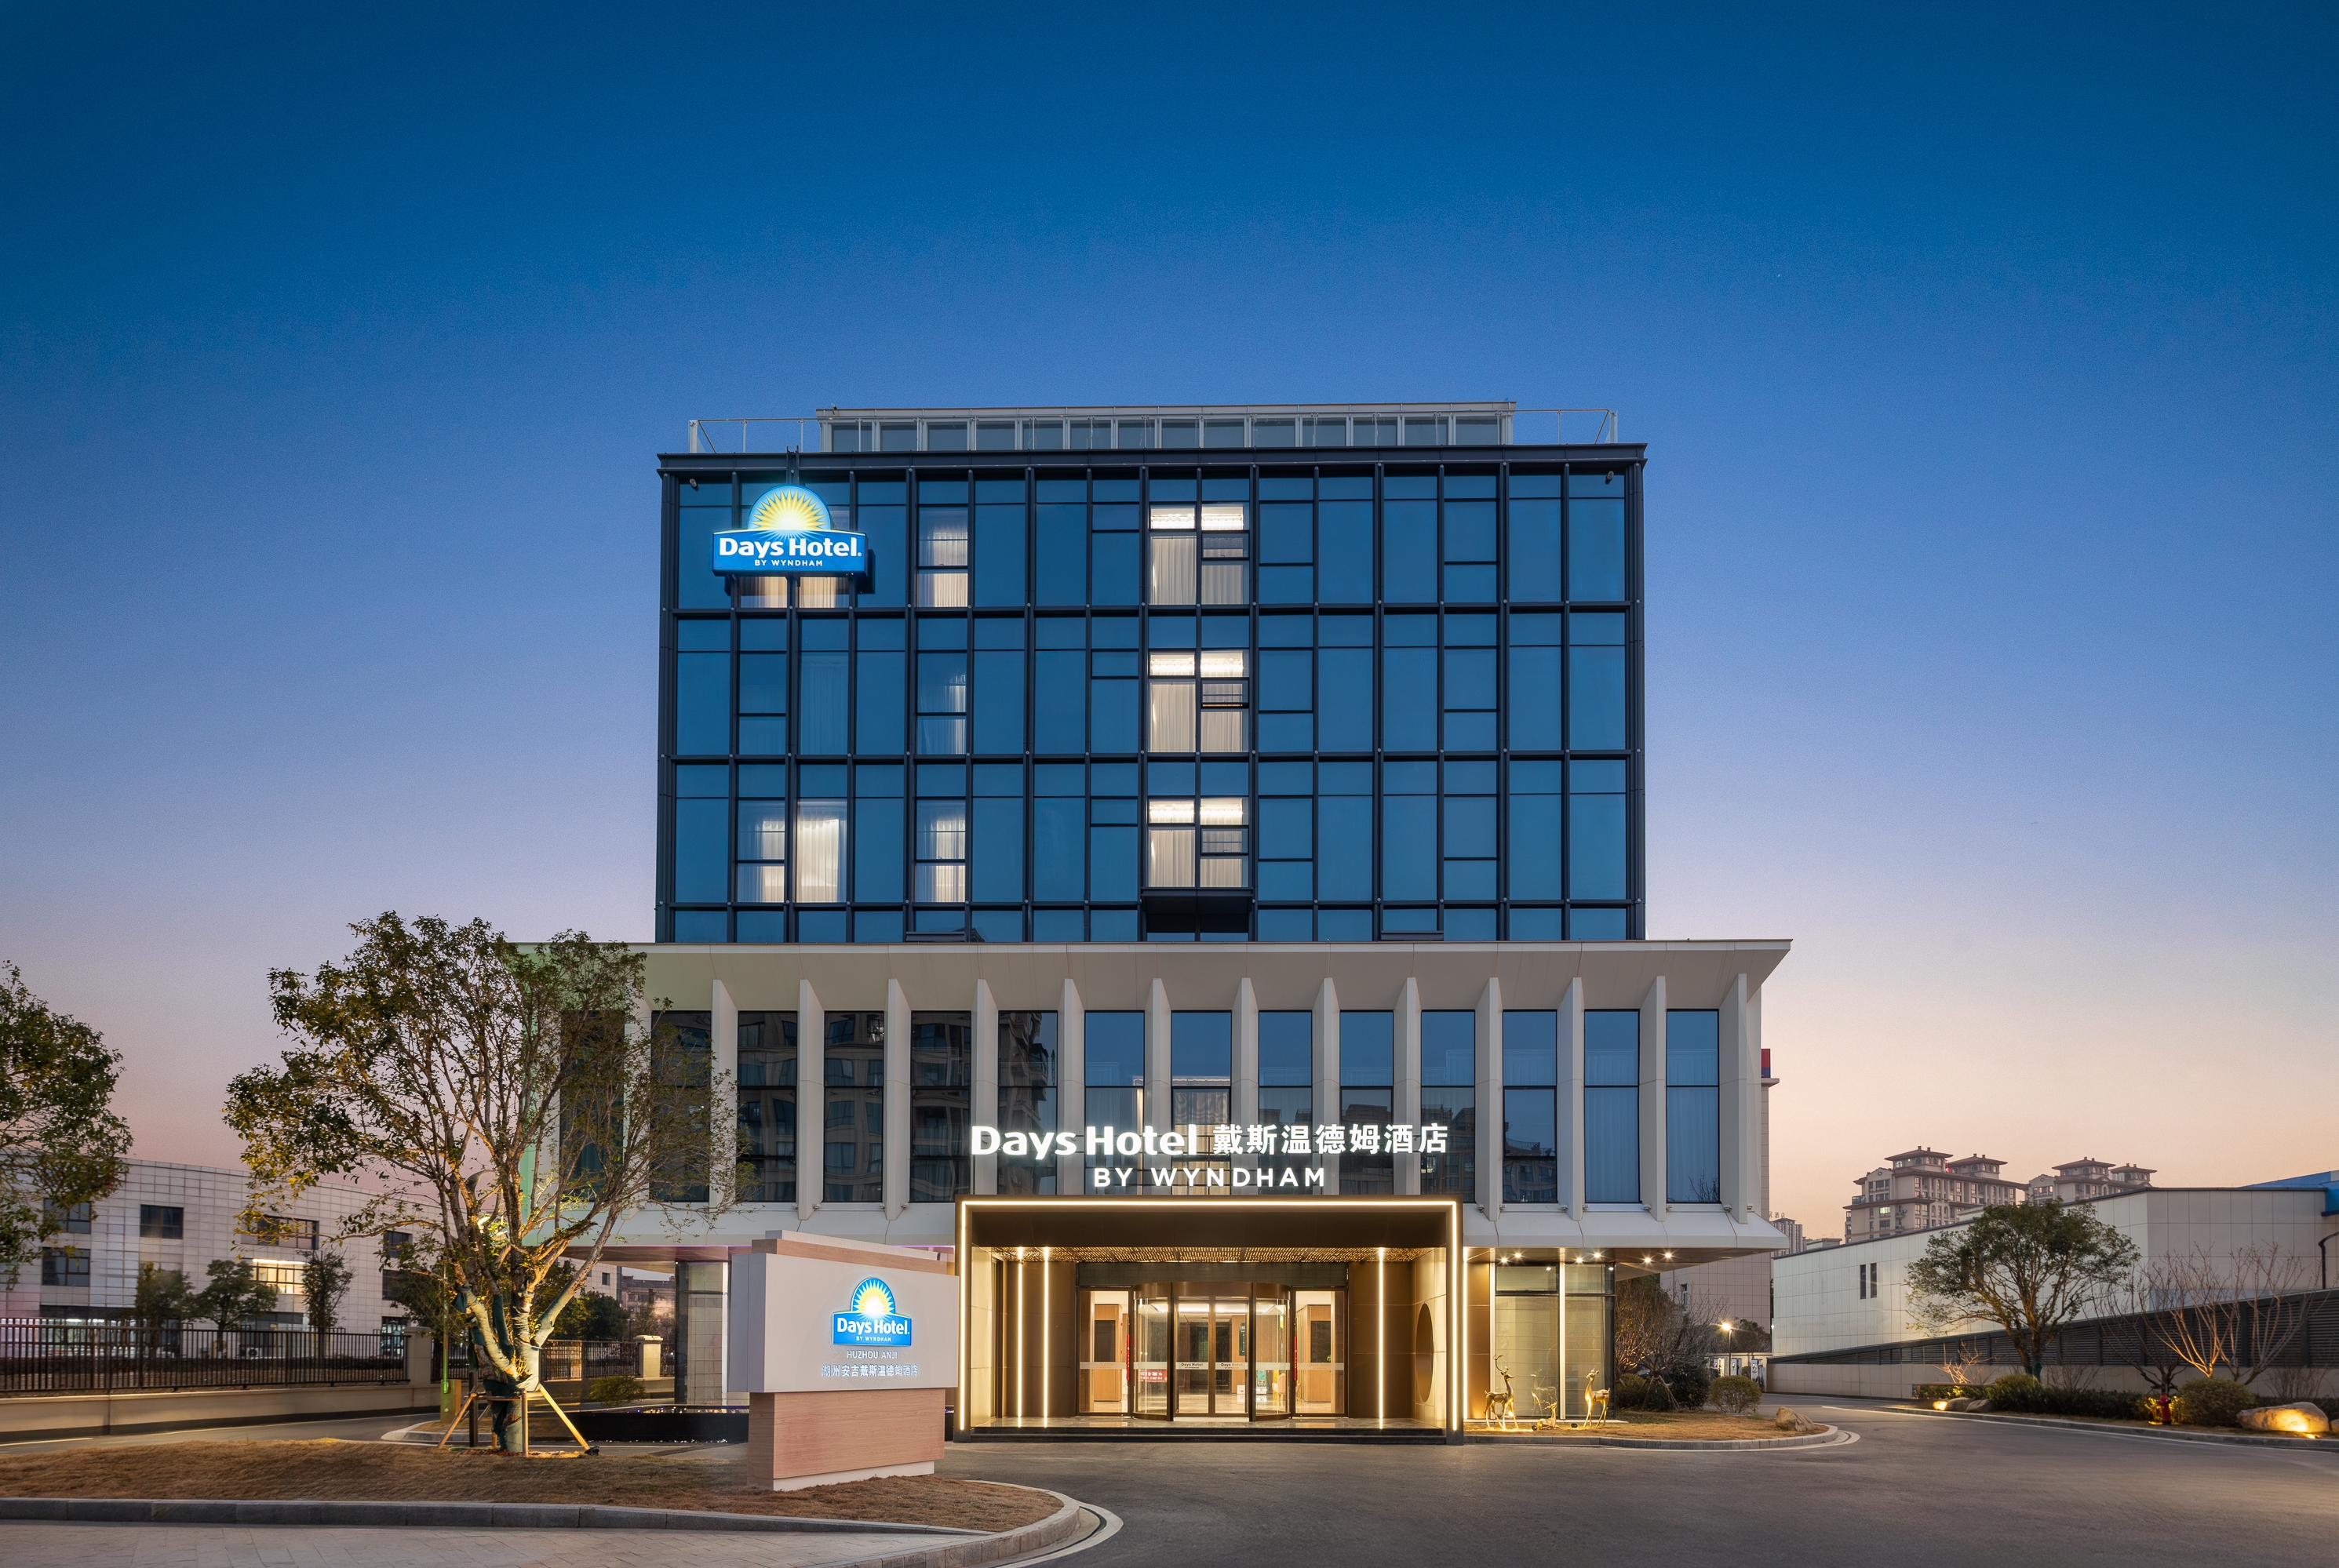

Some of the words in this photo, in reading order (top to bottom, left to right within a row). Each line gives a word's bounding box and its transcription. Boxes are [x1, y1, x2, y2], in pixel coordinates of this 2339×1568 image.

[719, 537, 785, 558] Days
[789, 537, 857, 557] Hotel
[971, 1125, 1077, 1160] Days
[1085, 1124, 1197, 1156] Hotel
[1212, 1124, 1449, 1155] 戴斯温德姆酒店
[1094, 1167, 1134, 1188] BY
[1150, 1167, 1326, 1188] WYNDHAM
[836, 1317, 873, 1335] Days
[873, 1319, 908, 1335] Hotel
[847, 1350, 879, 1359] HUZHOU
[880, 1350, 898, 1359] ANJI
[822, 1363, 920, 1377] 湖州安吉戴斯温德姆酒店
